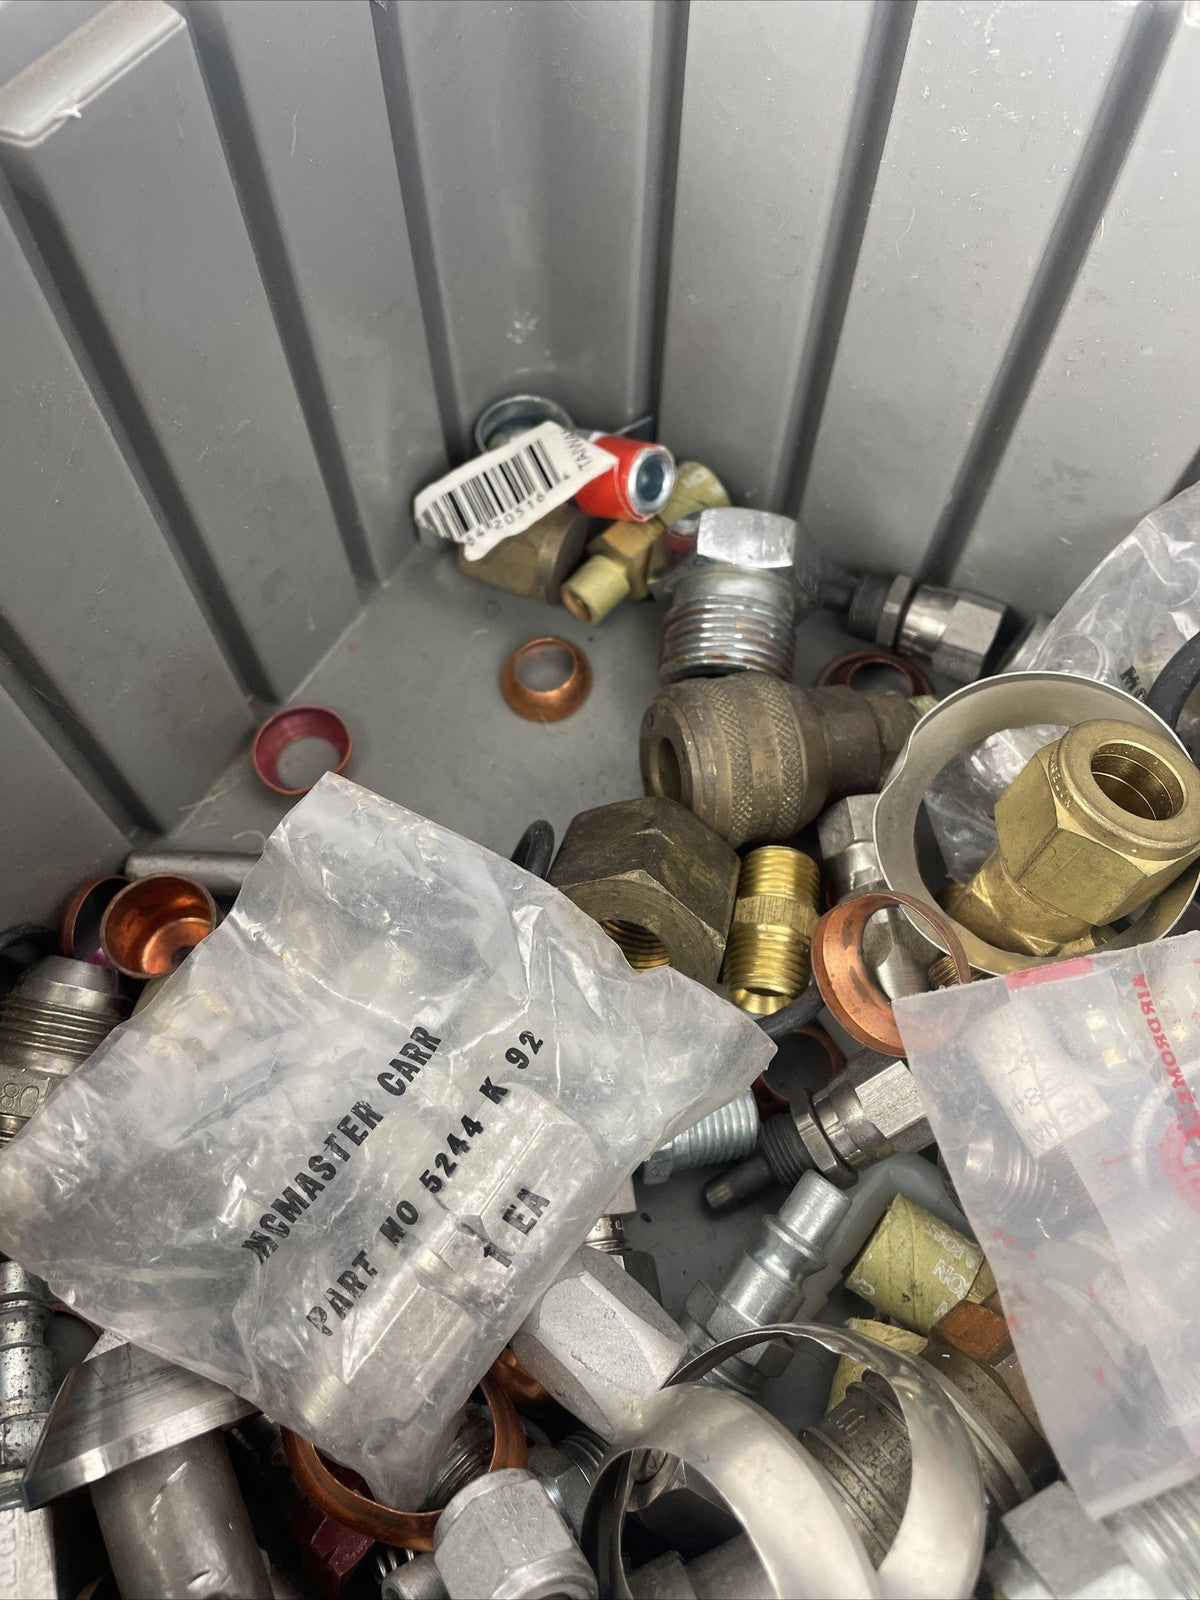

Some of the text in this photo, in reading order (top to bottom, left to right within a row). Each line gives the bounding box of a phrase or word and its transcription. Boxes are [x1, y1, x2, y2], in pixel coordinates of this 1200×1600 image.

[242, 1026, 442, 1265] MCMASTER CARR
[306, 1250, 378, 1337] PART
[419, 1114, 484, 1194] 5244
[478, 1076, 510, 1105] K
[505, 1030, 544, 1070] 92
[502, 1187, 550, 1236] EA
